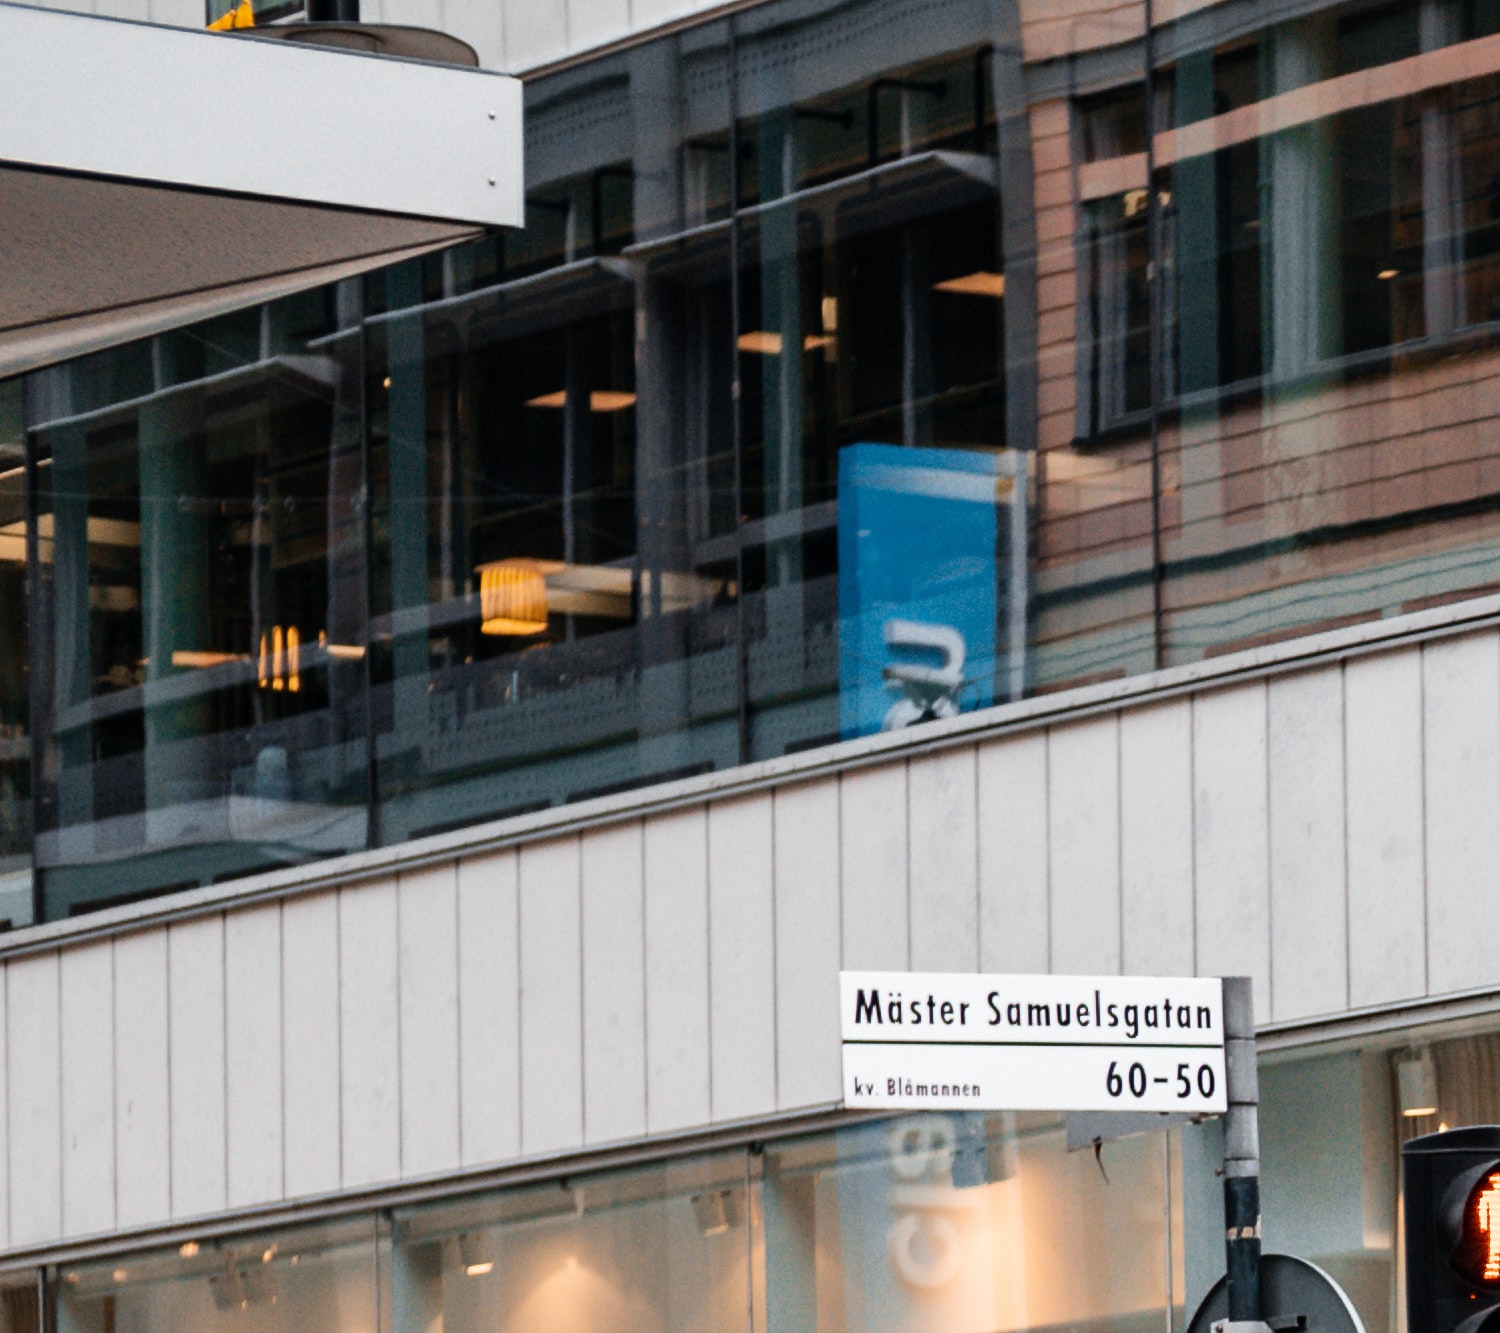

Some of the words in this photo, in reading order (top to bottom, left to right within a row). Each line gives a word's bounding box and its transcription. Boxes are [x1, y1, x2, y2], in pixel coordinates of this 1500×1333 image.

[855, 988, 970, 1025] Mäster
[987, 989, 1211, 1038] Samuelsgatan
[886, 1077, 981, 1097] Blåmannen
[1106, 1061, 1215, 1099] 60-50
